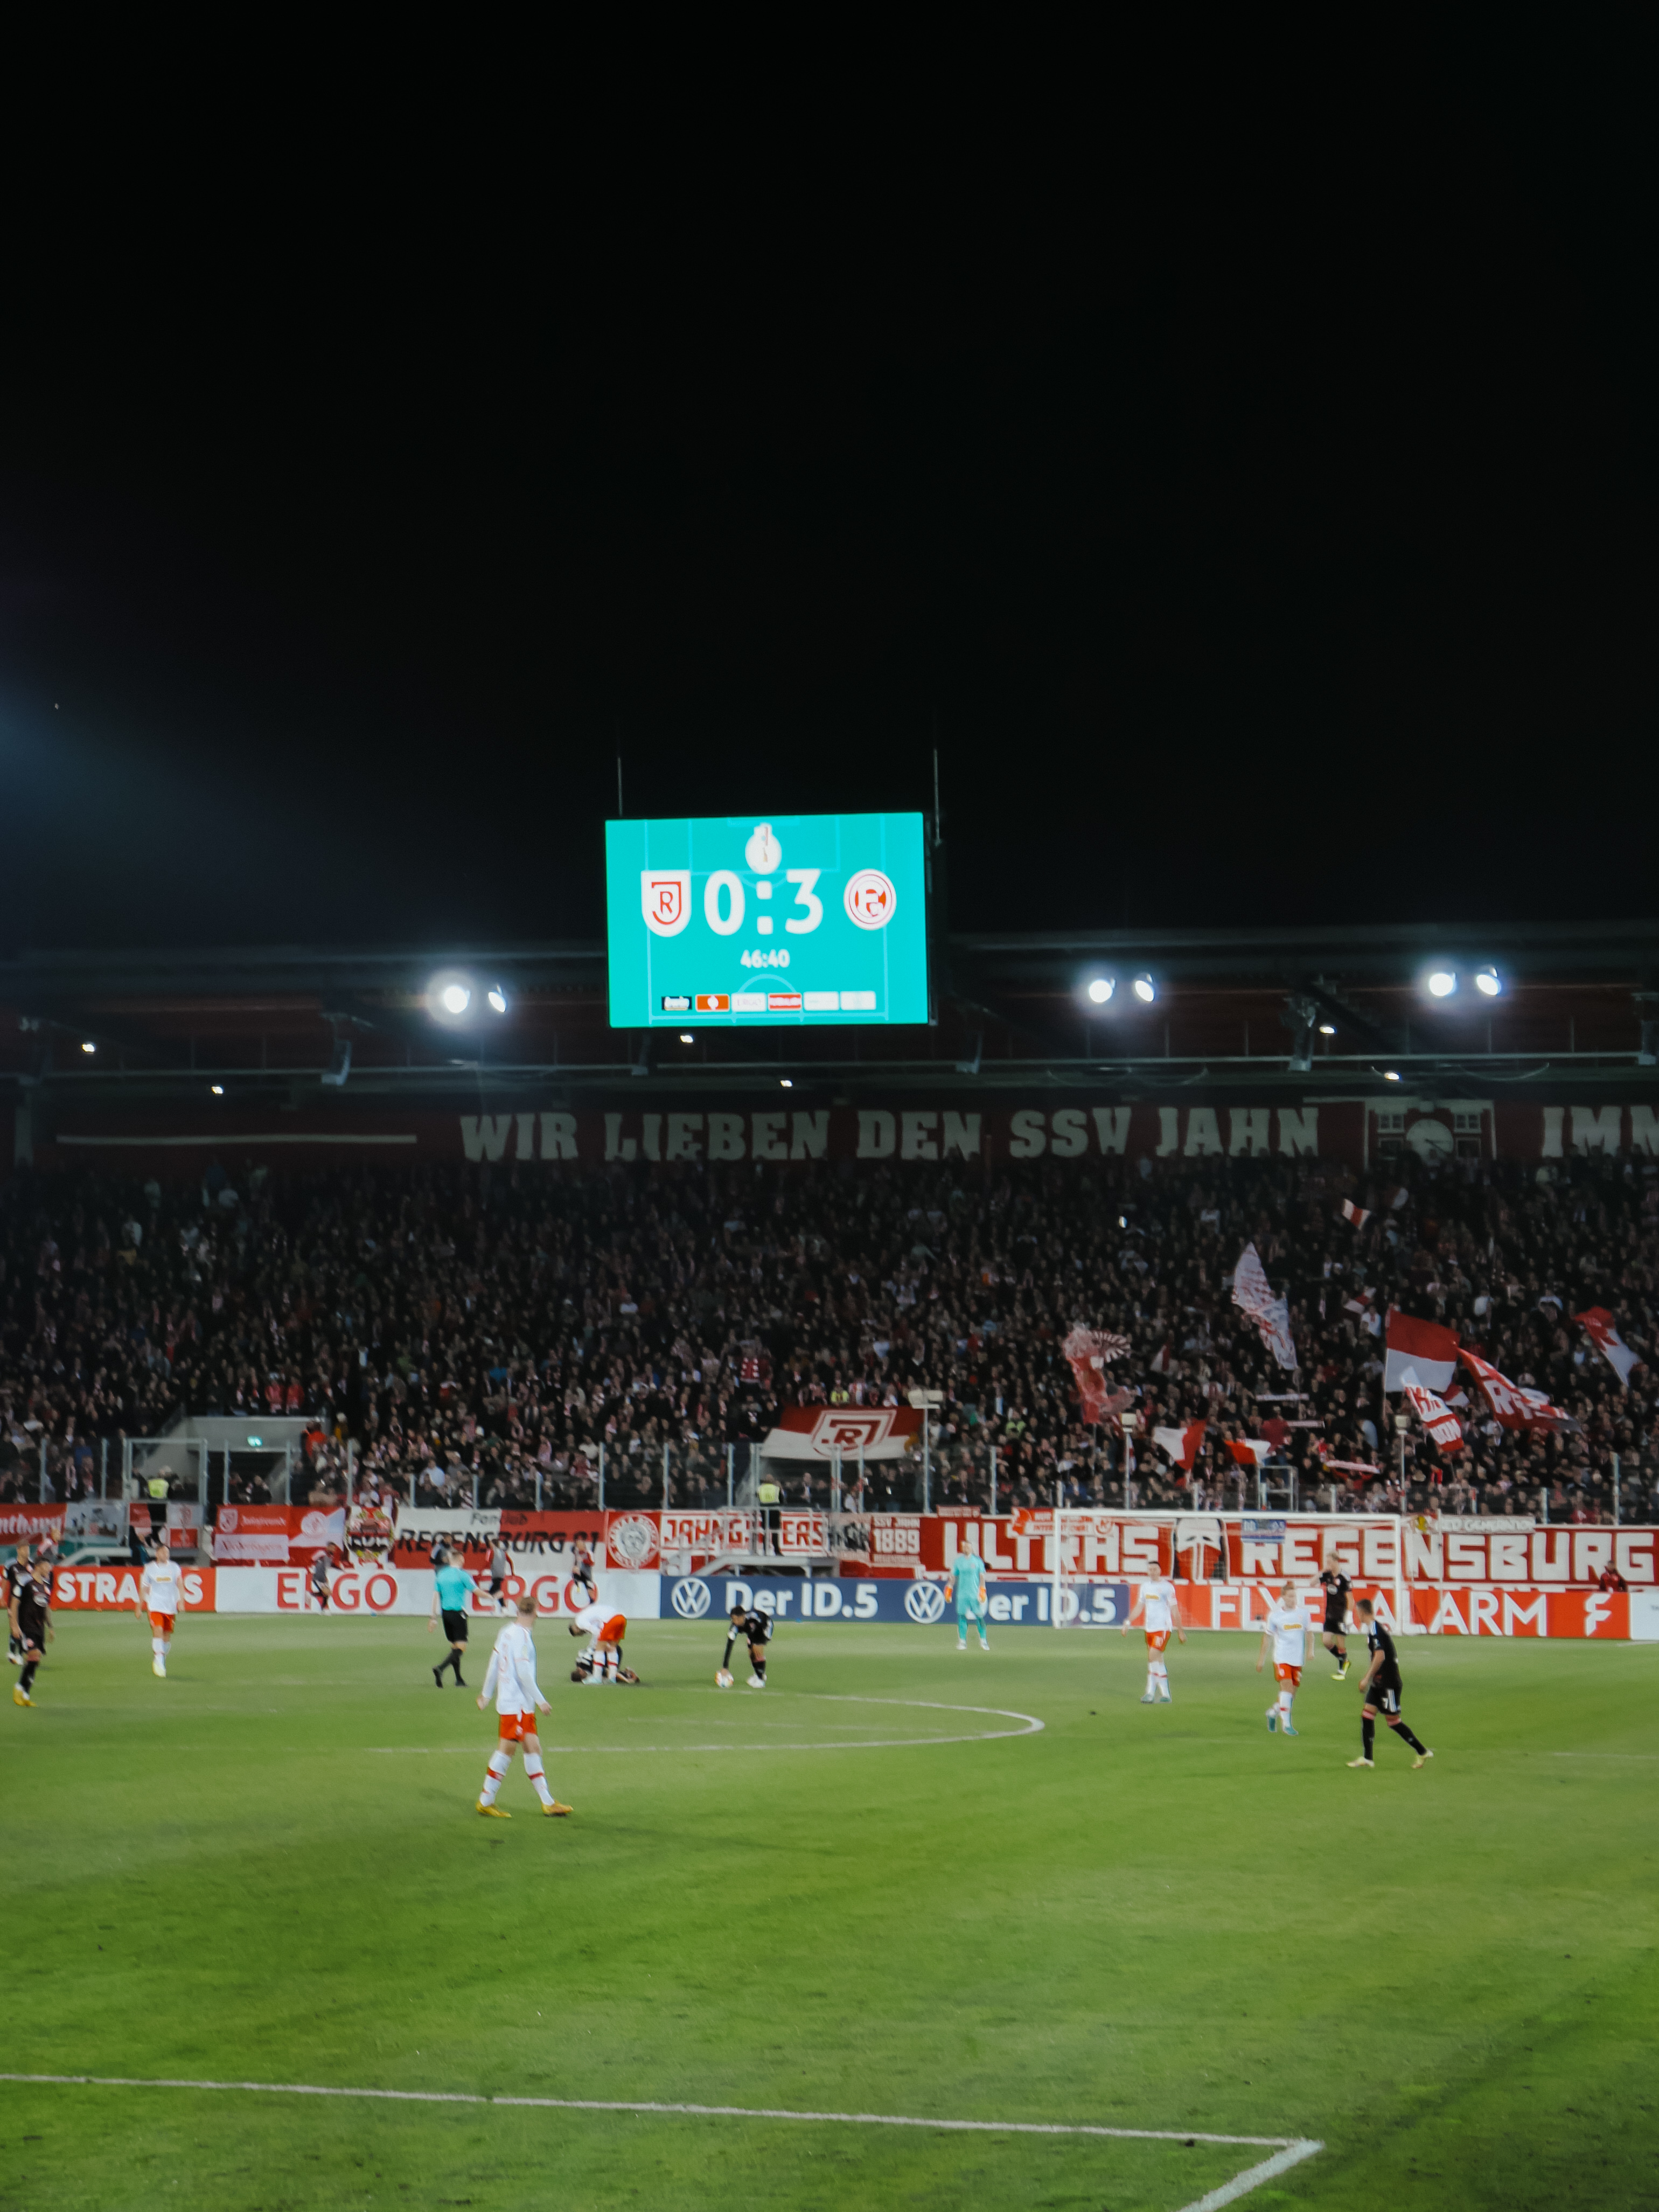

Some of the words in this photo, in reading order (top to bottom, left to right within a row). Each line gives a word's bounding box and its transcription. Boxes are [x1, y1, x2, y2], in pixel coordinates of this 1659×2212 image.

[740, 948, 791, 969] 46:40
[460, 1112, 579, 1162] WIR
[604, 1110, 830, 1161] LIEBEN
[856, 1110, 982, 1160] DEN
[1009, 1108, 1132, 1158] SSV
[1155, 1108, 1319, 1158] JAHN
[873, 1528, 920, 1554] 1889
[725, 1582, 793, 1616] Der
[801, 1583, 879, 1618] ID.5
[1036, 1587, 1117, 1623] ID.5
